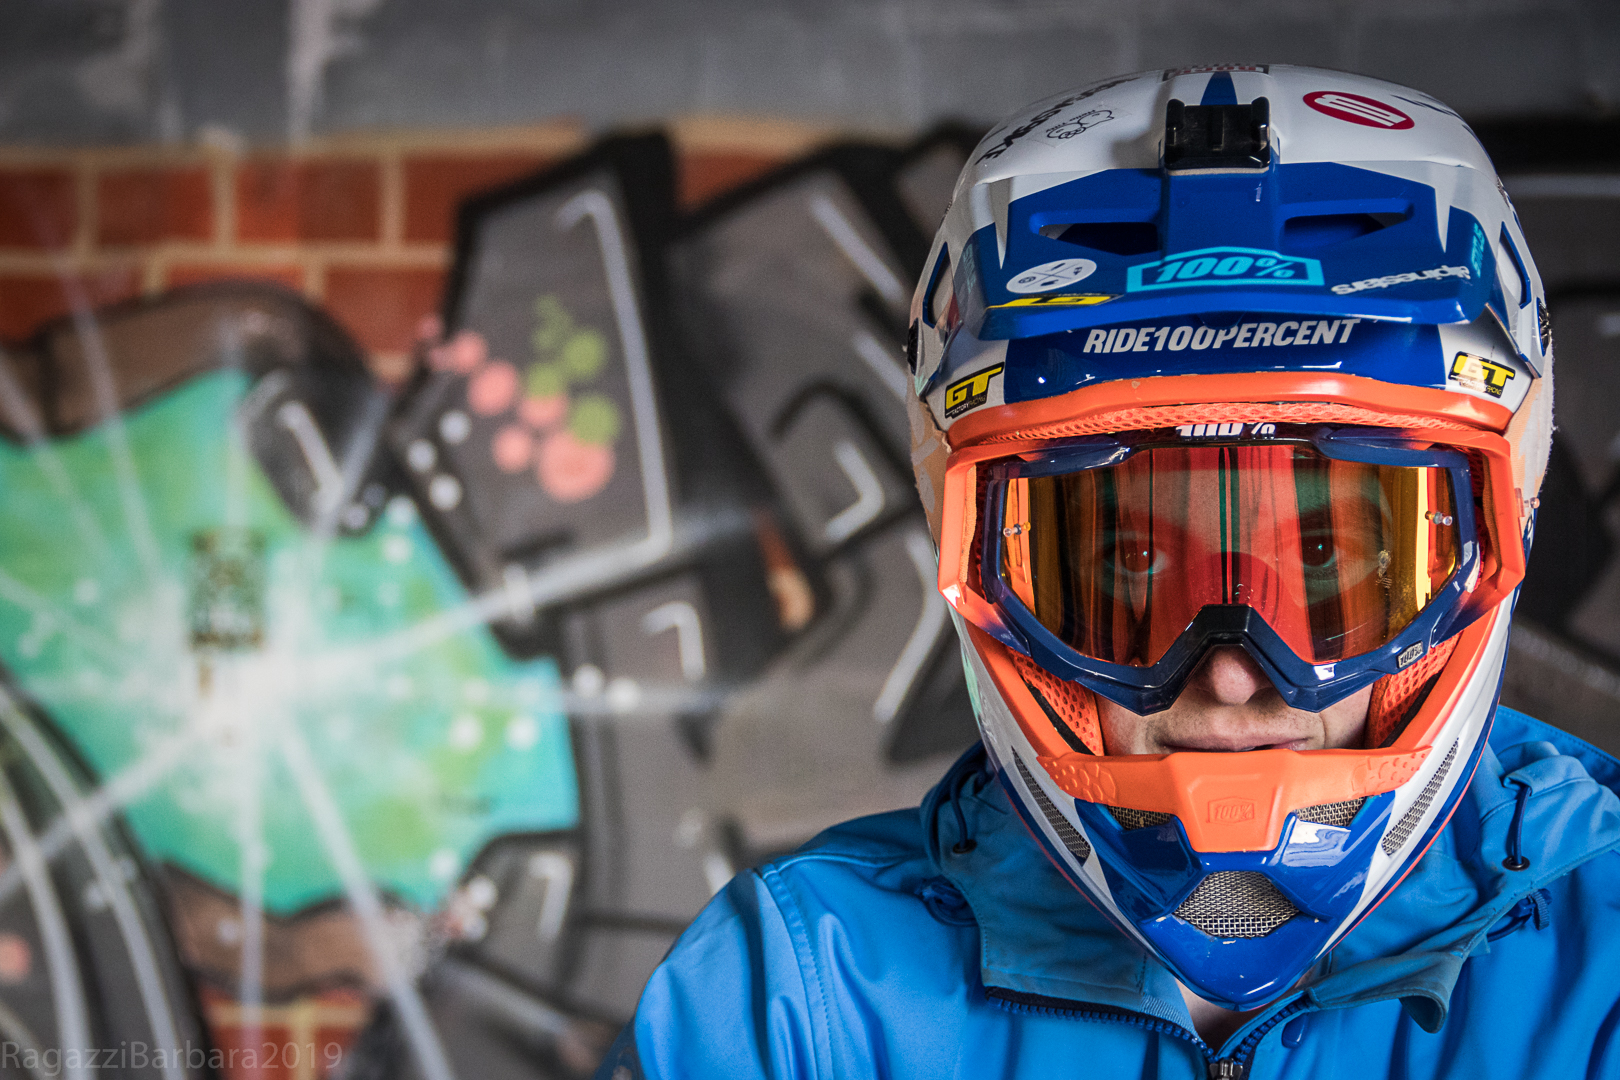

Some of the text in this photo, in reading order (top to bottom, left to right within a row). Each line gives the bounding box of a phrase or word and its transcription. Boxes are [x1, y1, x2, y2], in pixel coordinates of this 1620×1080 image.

[1156, 256, 1296, 283] 100%
[1083, 318, 1361, 354] RIDE100PERCENT
[1453, 355, 1515, 387] GT
[946, 366, 1002, 410] GT
[1215, 804, 1253, 820] 100%
